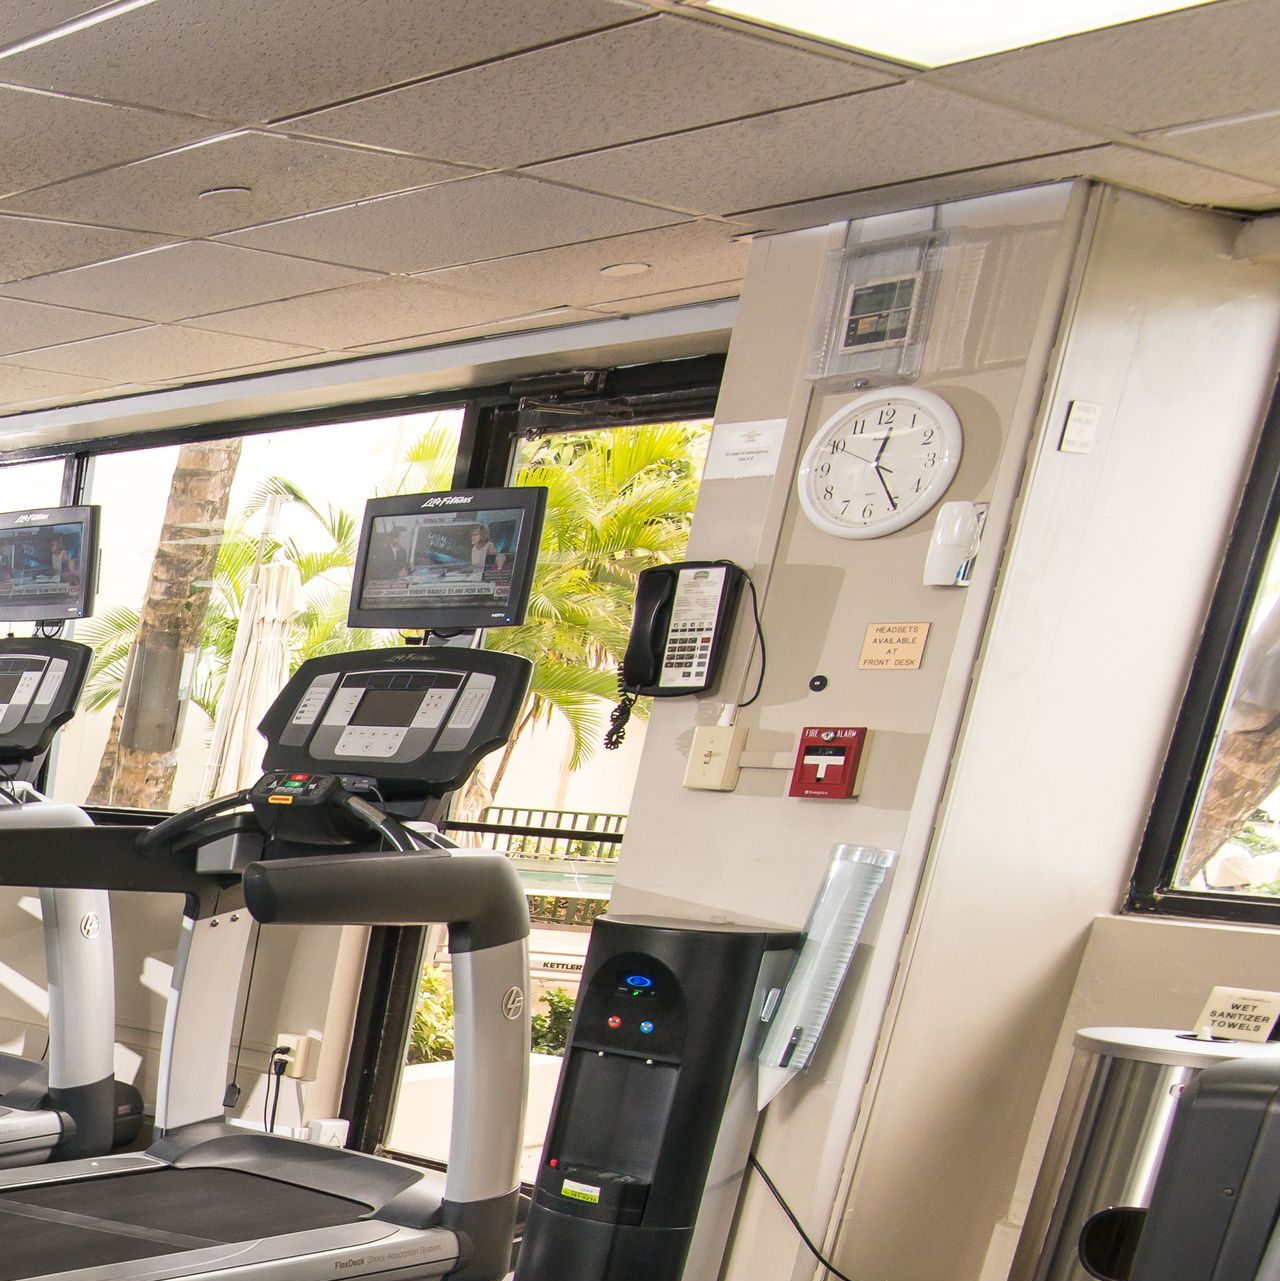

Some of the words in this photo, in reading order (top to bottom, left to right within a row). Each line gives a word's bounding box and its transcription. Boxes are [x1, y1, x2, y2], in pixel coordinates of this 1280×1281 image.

[877, 408, 896, 425] 12
[911, 413, 917, 428] 1
[852, 419, 866, 435] 11
[921, 429, 934, 446] 2
[830, 439, 846, 455] 10
[924, 452, 936, 468] 3
[819, 463, 831, 478] 9
[823, 485, 834, 501] 8
[840, 500, 851, 516] 7
[862, 503, 874, 519] 6
[805, 729, 819, 738] FIRE
[836, 729, 857, 738] ALARM
[543, 962, 583, 971] KETTLER
[1231, 1003, 1258, 1012] WET
[1209, 1010, 1271, 1024] SANITIZER
[1210, 1019, 1261, 1032] TOWELS
